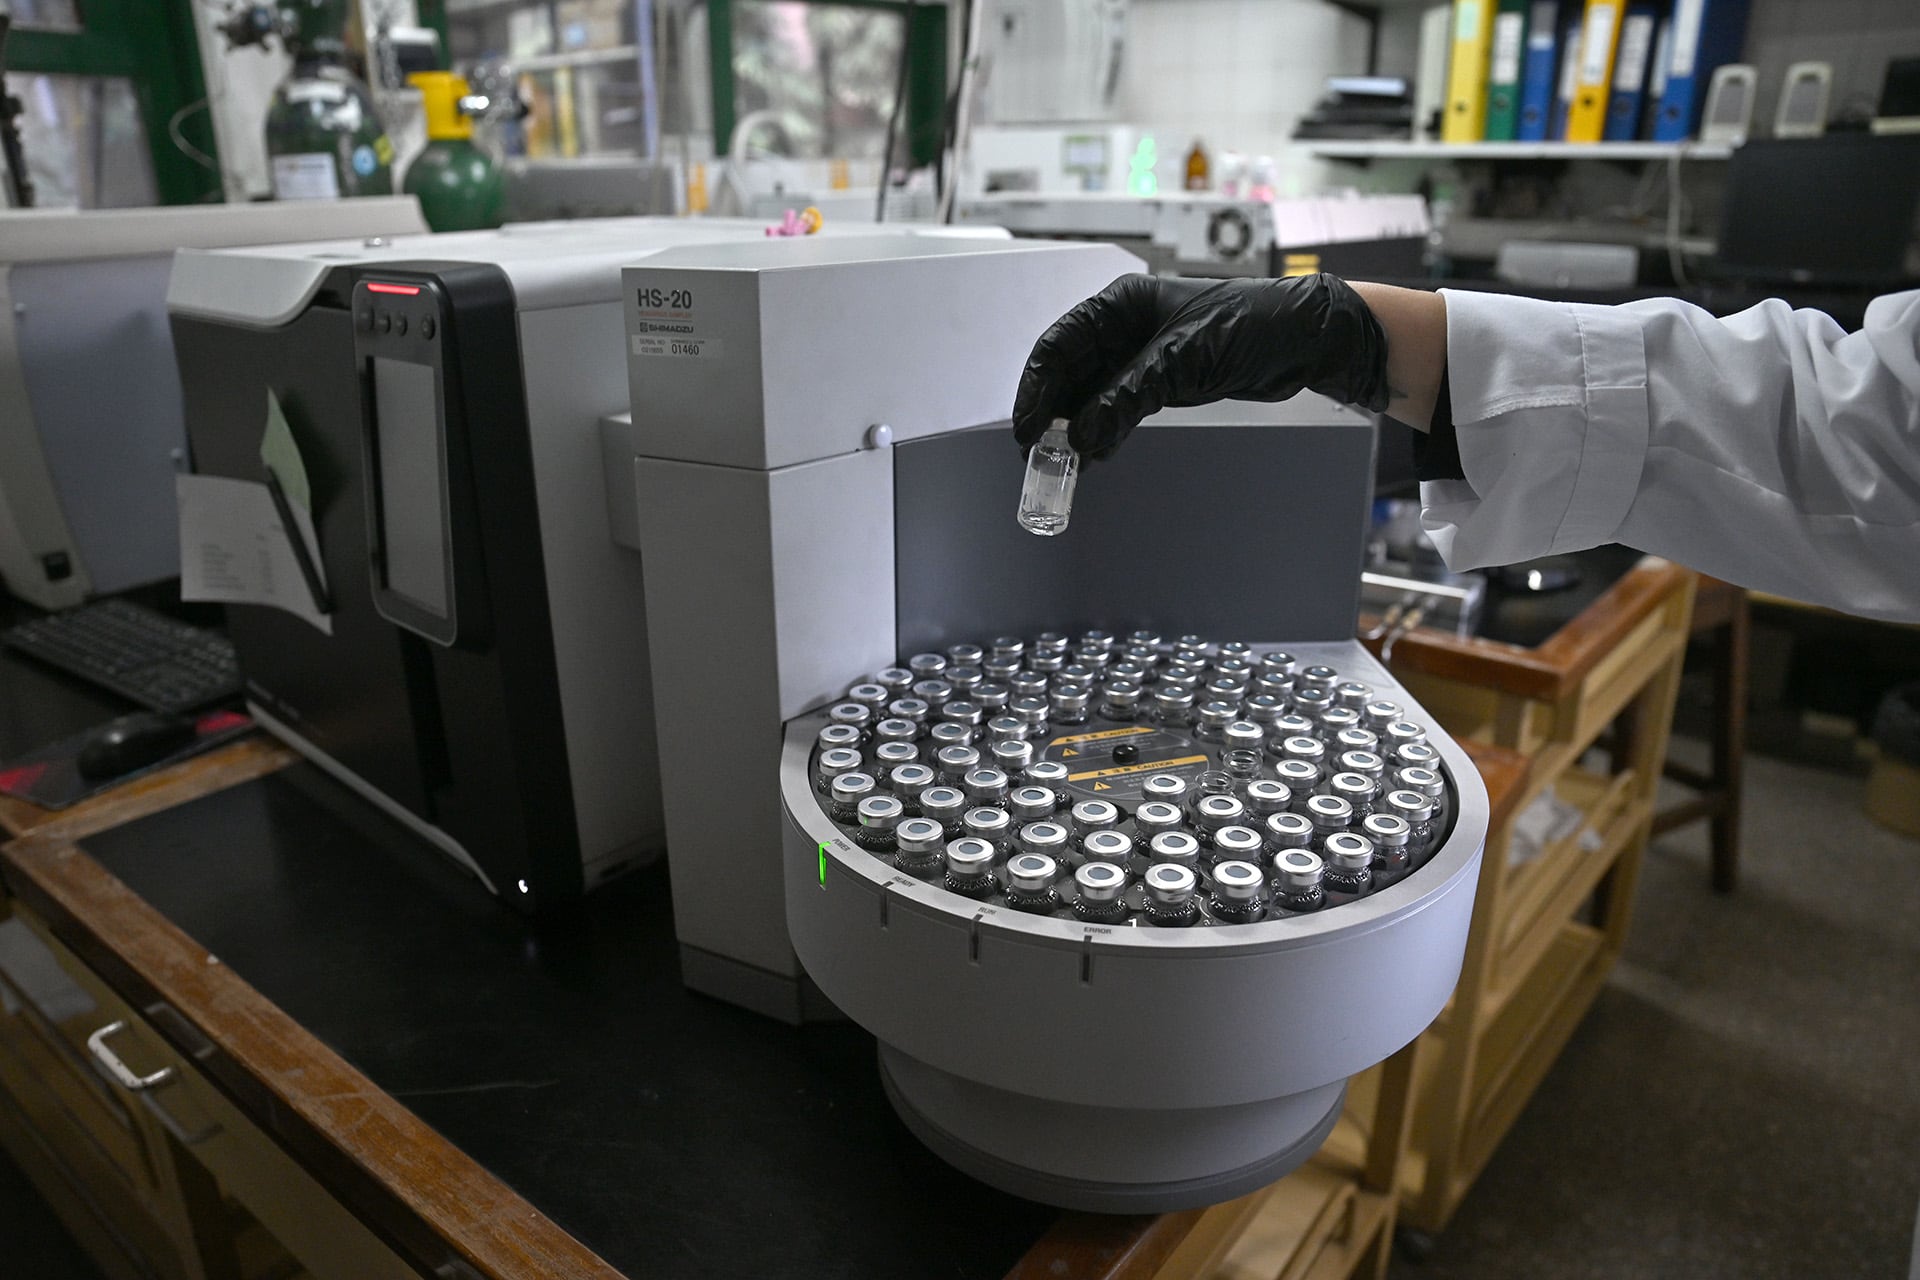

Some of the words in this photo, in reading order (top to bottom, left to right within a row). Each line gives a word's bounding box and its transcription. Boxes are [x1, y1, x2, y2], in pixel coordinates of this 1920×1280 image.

[637, 288, 692, 309] HS-20
[648, 324, 694, 333] SHIMADZU
[671, 343, 699, 355] 01460
[1136, 761, 1174, 770] CAUTION
[1083, 926, 1112, 935] ERROR
